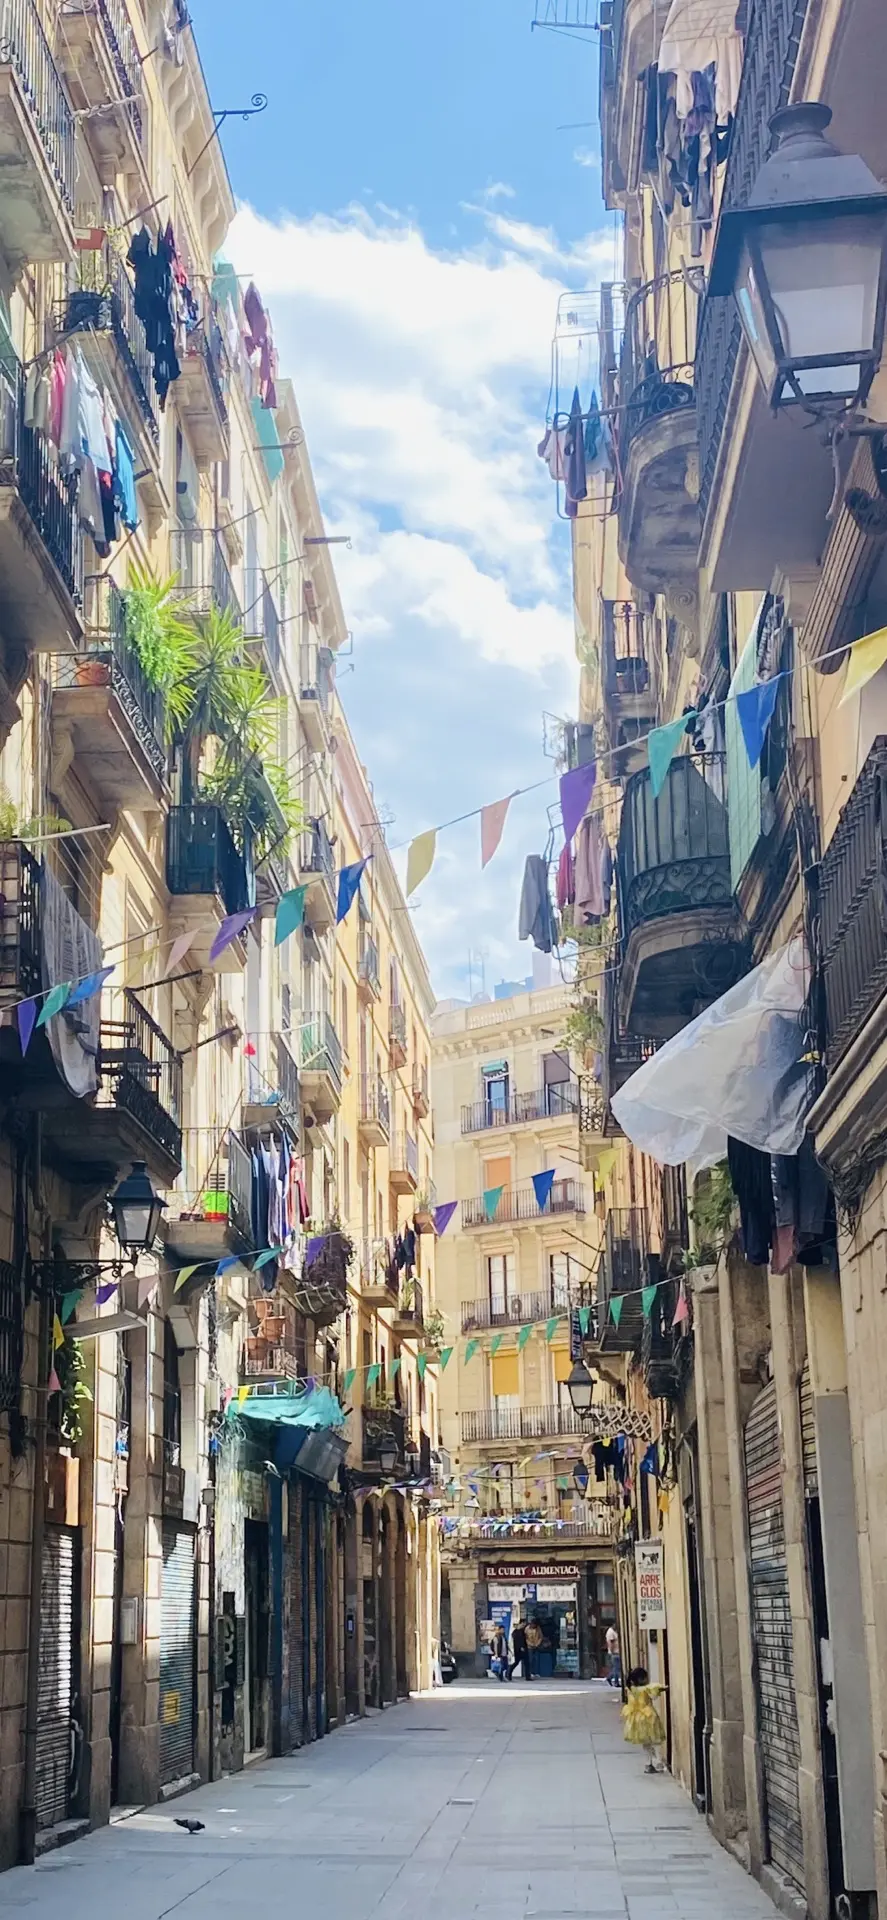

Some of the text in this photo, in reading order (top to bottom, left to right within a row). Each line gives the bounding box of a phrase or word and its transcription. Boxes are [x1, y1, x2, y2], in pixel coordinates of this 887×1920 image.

[486, 1567, 496, 1576] EL
[498, 1566, 528, 1576] CURRY
[640, 1574, 661, 1586] ARRE
[640, 1587, 662, 1599] GLOS
